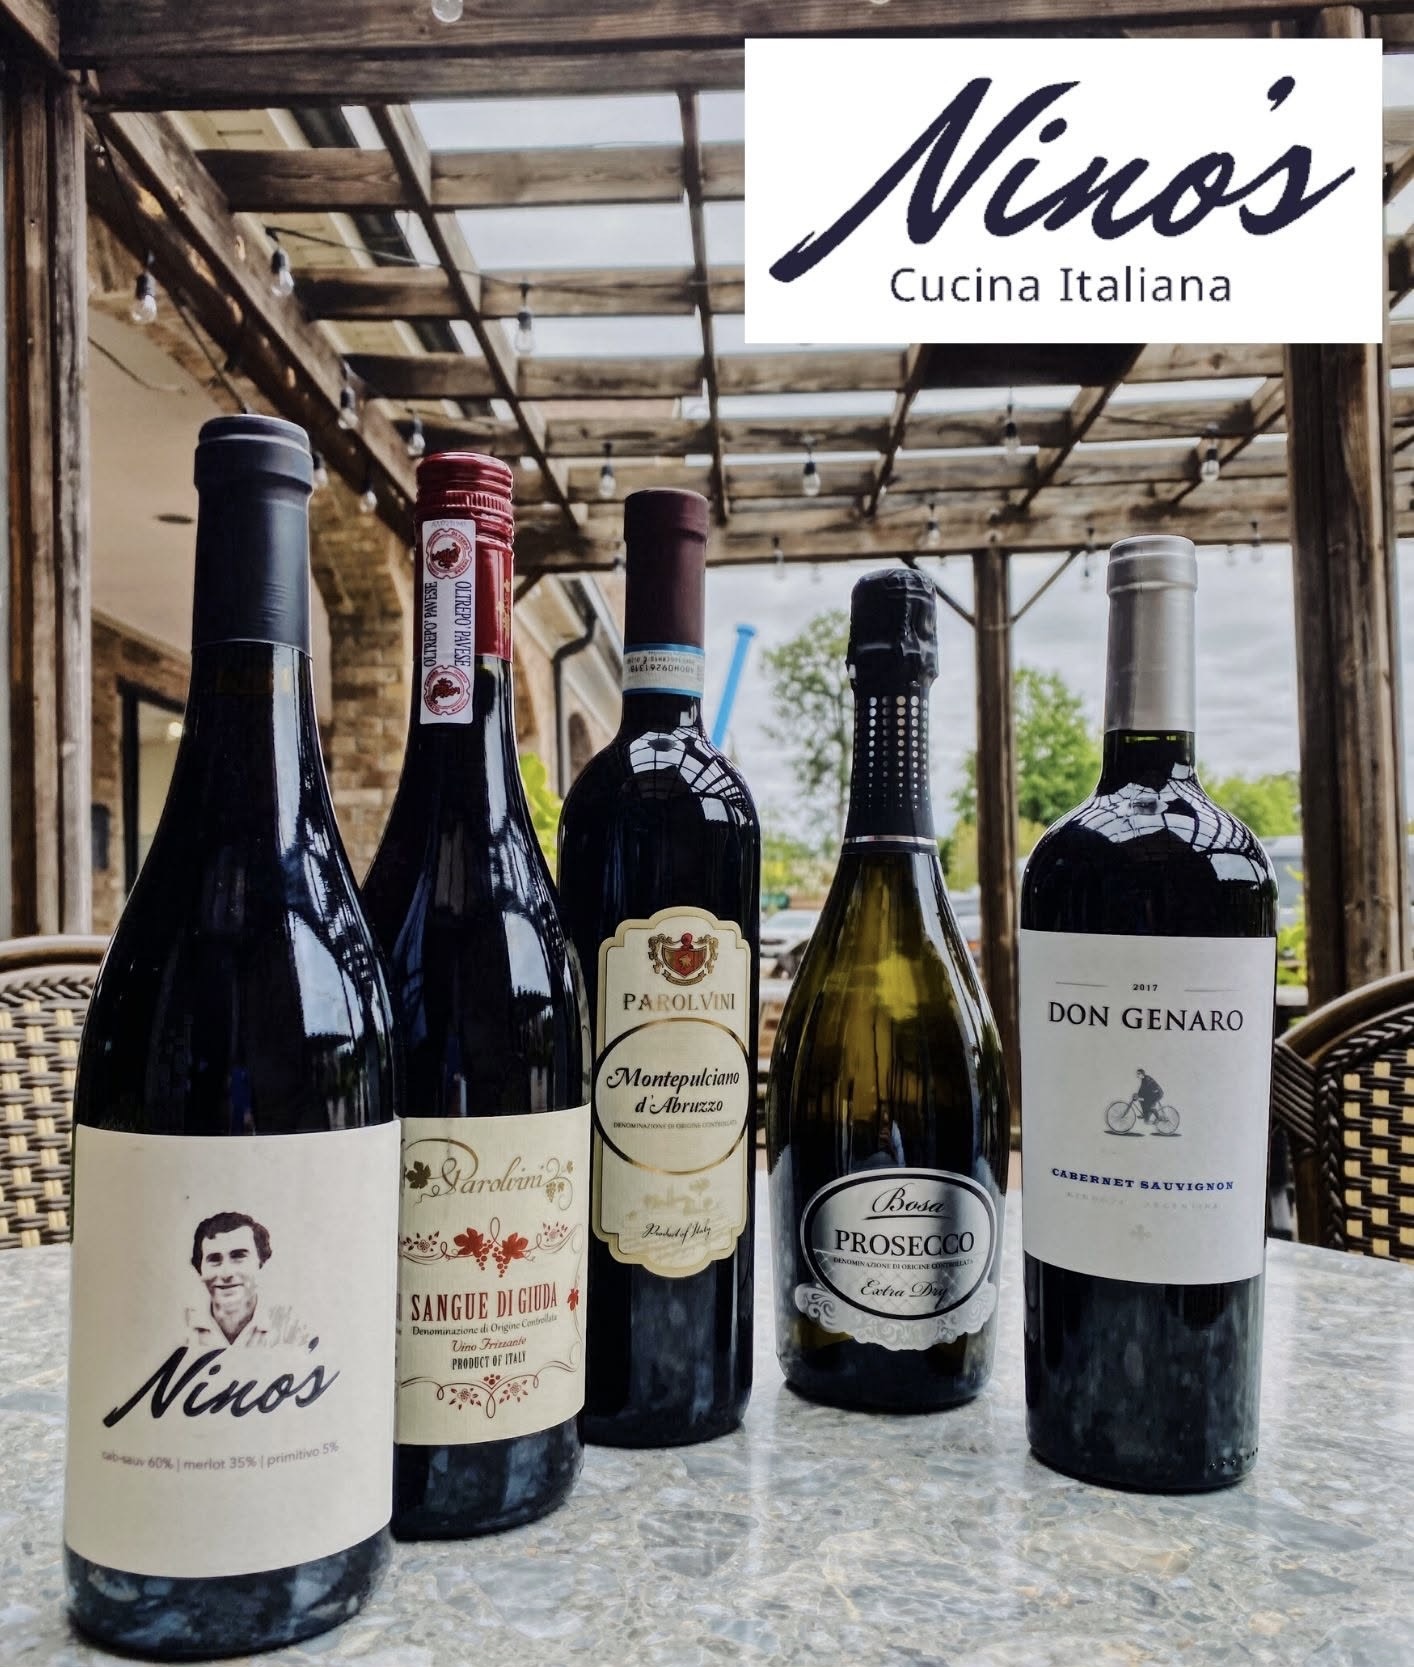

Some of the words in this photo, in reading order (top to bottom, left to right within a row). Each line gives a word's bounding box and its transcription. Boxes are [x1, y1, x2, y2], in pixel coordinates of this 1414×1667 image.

[424, 581, 437, 618] PAVESE
[454, 630, 471, 666] PAVESE
[623, 992, 735, 1011] PAROLVINI
[1132, 983, 1158, 992] 2017
[1049, 1001, 1110, 1027] DON
[1121, 1006, 1244, 1032] GENARO
[606, 1067, 740, 1095] Montepulciano
[635, 1095, 723, 1114] d'Abruzzo
[420, 1138, 547, 1194] Parolvini
[1052, 1168, 1134, 1188] CABERNET
[1140, 1181, 1234, 1191] SAUVIGNON
[871, 1183, 945, 1213] Bosa
[834, 1229, 975, 1257] PROSECCO
[411, 1292, 489, 1322] SANGUE
[497, 1289, 514, 1318] DI
[518, 1281, 558, 1315] GIUDA
[860, 1278, 905, 1297] Extra
[908, 1280, 949, 1309] Dry
[412, 1326, 478, 1336] Denominazione
[480, 1324, 489, 1334] di
[490, 1320, 520, 1334] Origine
[451, 1340, 477, 1352] Vino
[479, 1336, 527, 1351] Frizzante
[452, 1356, 489, 1370] PRODUCT
[492, 1355, 503, 1367] OF
[505, 1351, 526, 1364] ITALY
[103, 1336, 340, 1427] Nino's
[148, 1457, 174, 1470] 60%
[184, 1458, 225, 1471] merlot
[229, 1457, 257, 1469] 35%
[267, 1446, 320, 1468] primitivo
[322, 1441, 340, 1455] 5%
